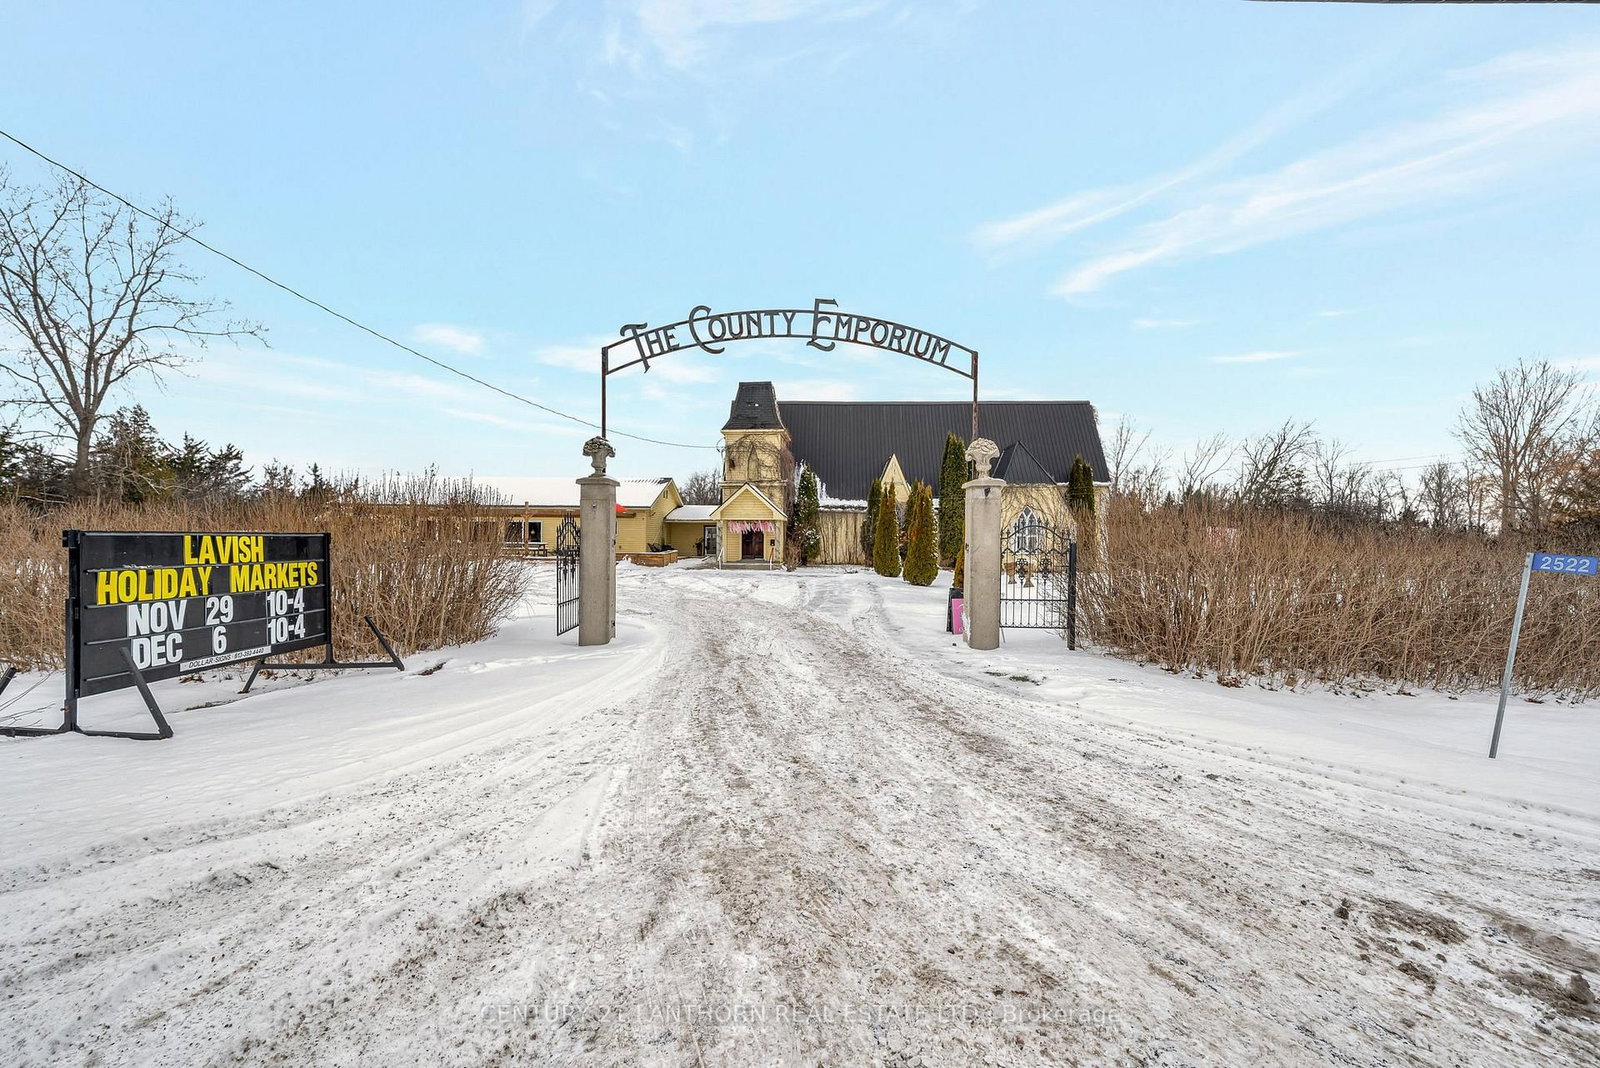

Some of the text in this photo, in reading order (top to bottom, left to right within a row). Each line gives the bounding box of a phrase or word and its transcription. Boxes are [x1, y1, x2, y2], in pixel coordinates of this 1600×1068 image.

[620, 298, 951, 373] THE COUNTY EMPORIUM
[184, 535, 264, 565] LAVISH
[1540, 556, 1590, 573] 2522
[96, 562, 318, 605] HOLIDAY MARKETS
[127, 589, 305, 637] NOV 29 10-4
[131, 614, 305, 670] DEC 6 10-4
